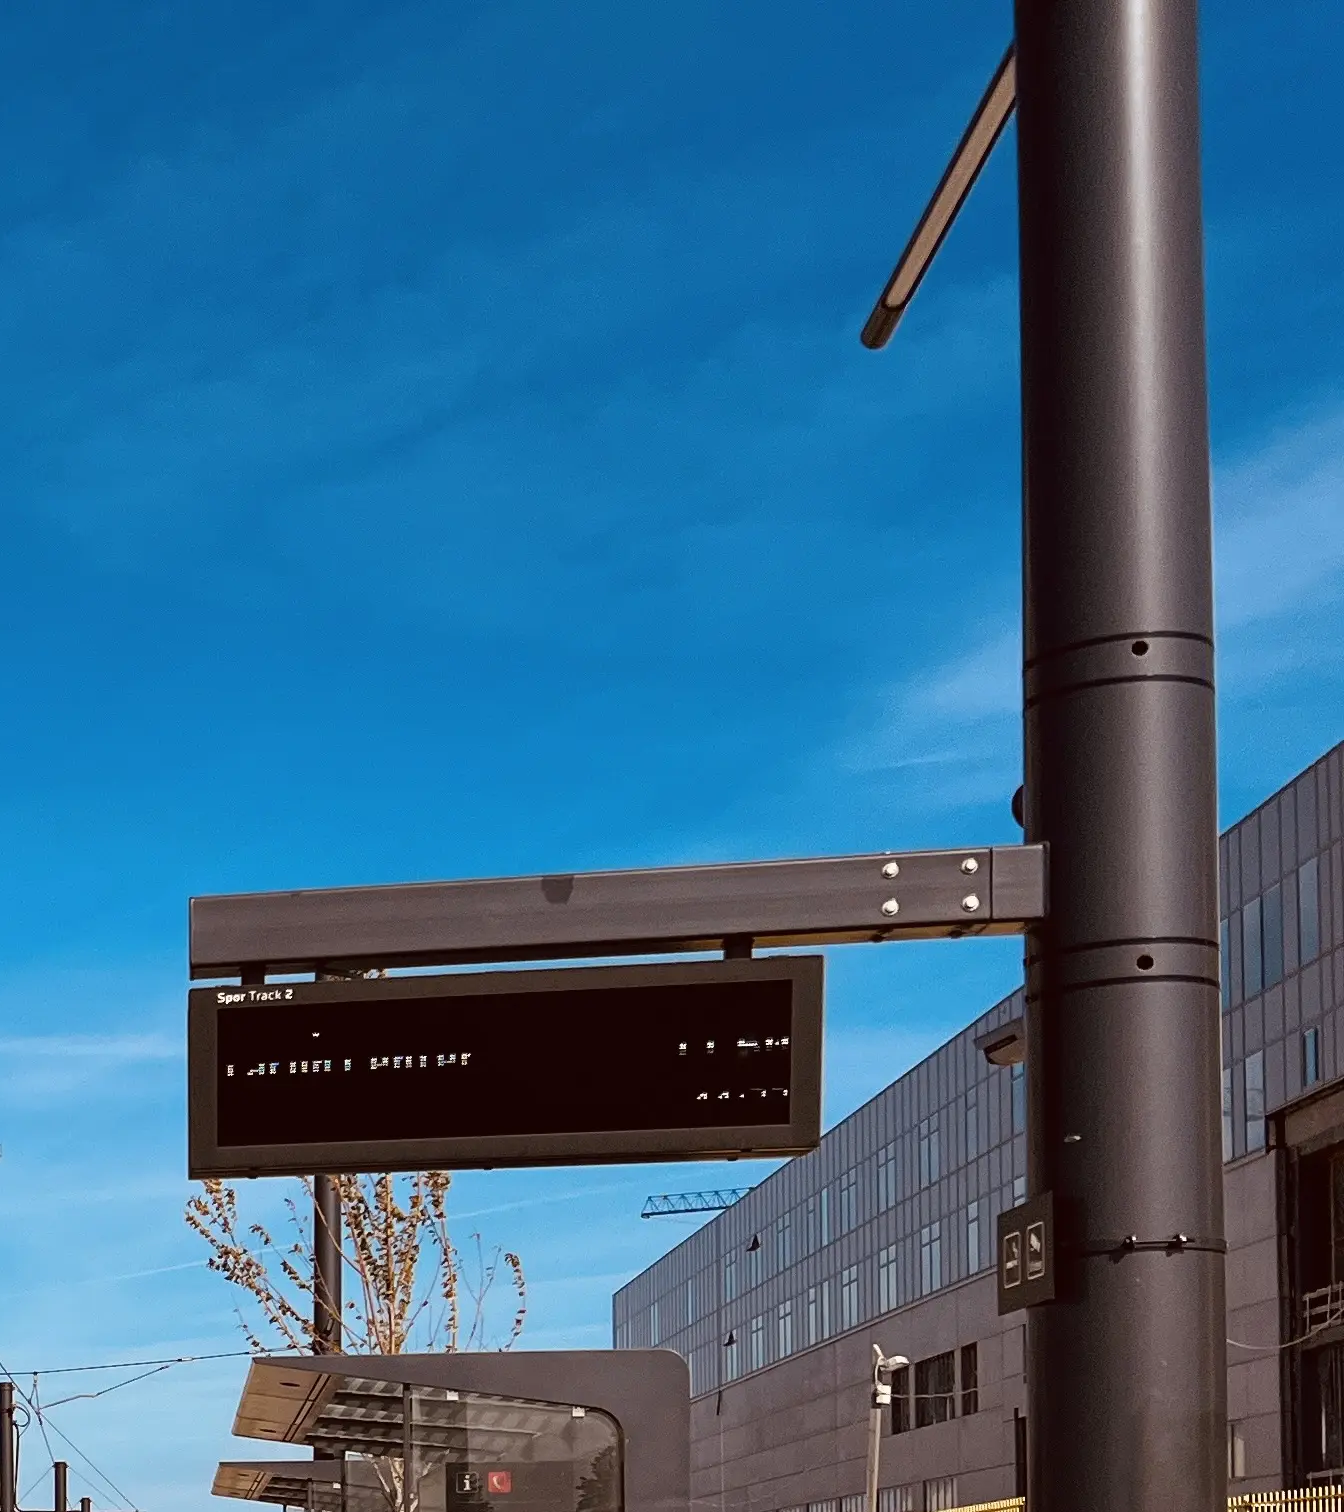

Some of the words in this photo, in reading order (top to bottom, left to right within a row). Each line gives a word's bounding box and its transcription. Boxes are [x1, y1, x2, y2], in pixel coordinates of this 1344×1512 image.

[217, 992, 246, 1004] Spor
[248, 989, 282, 1001] Track
[284, 988, 293, 1000] 2
